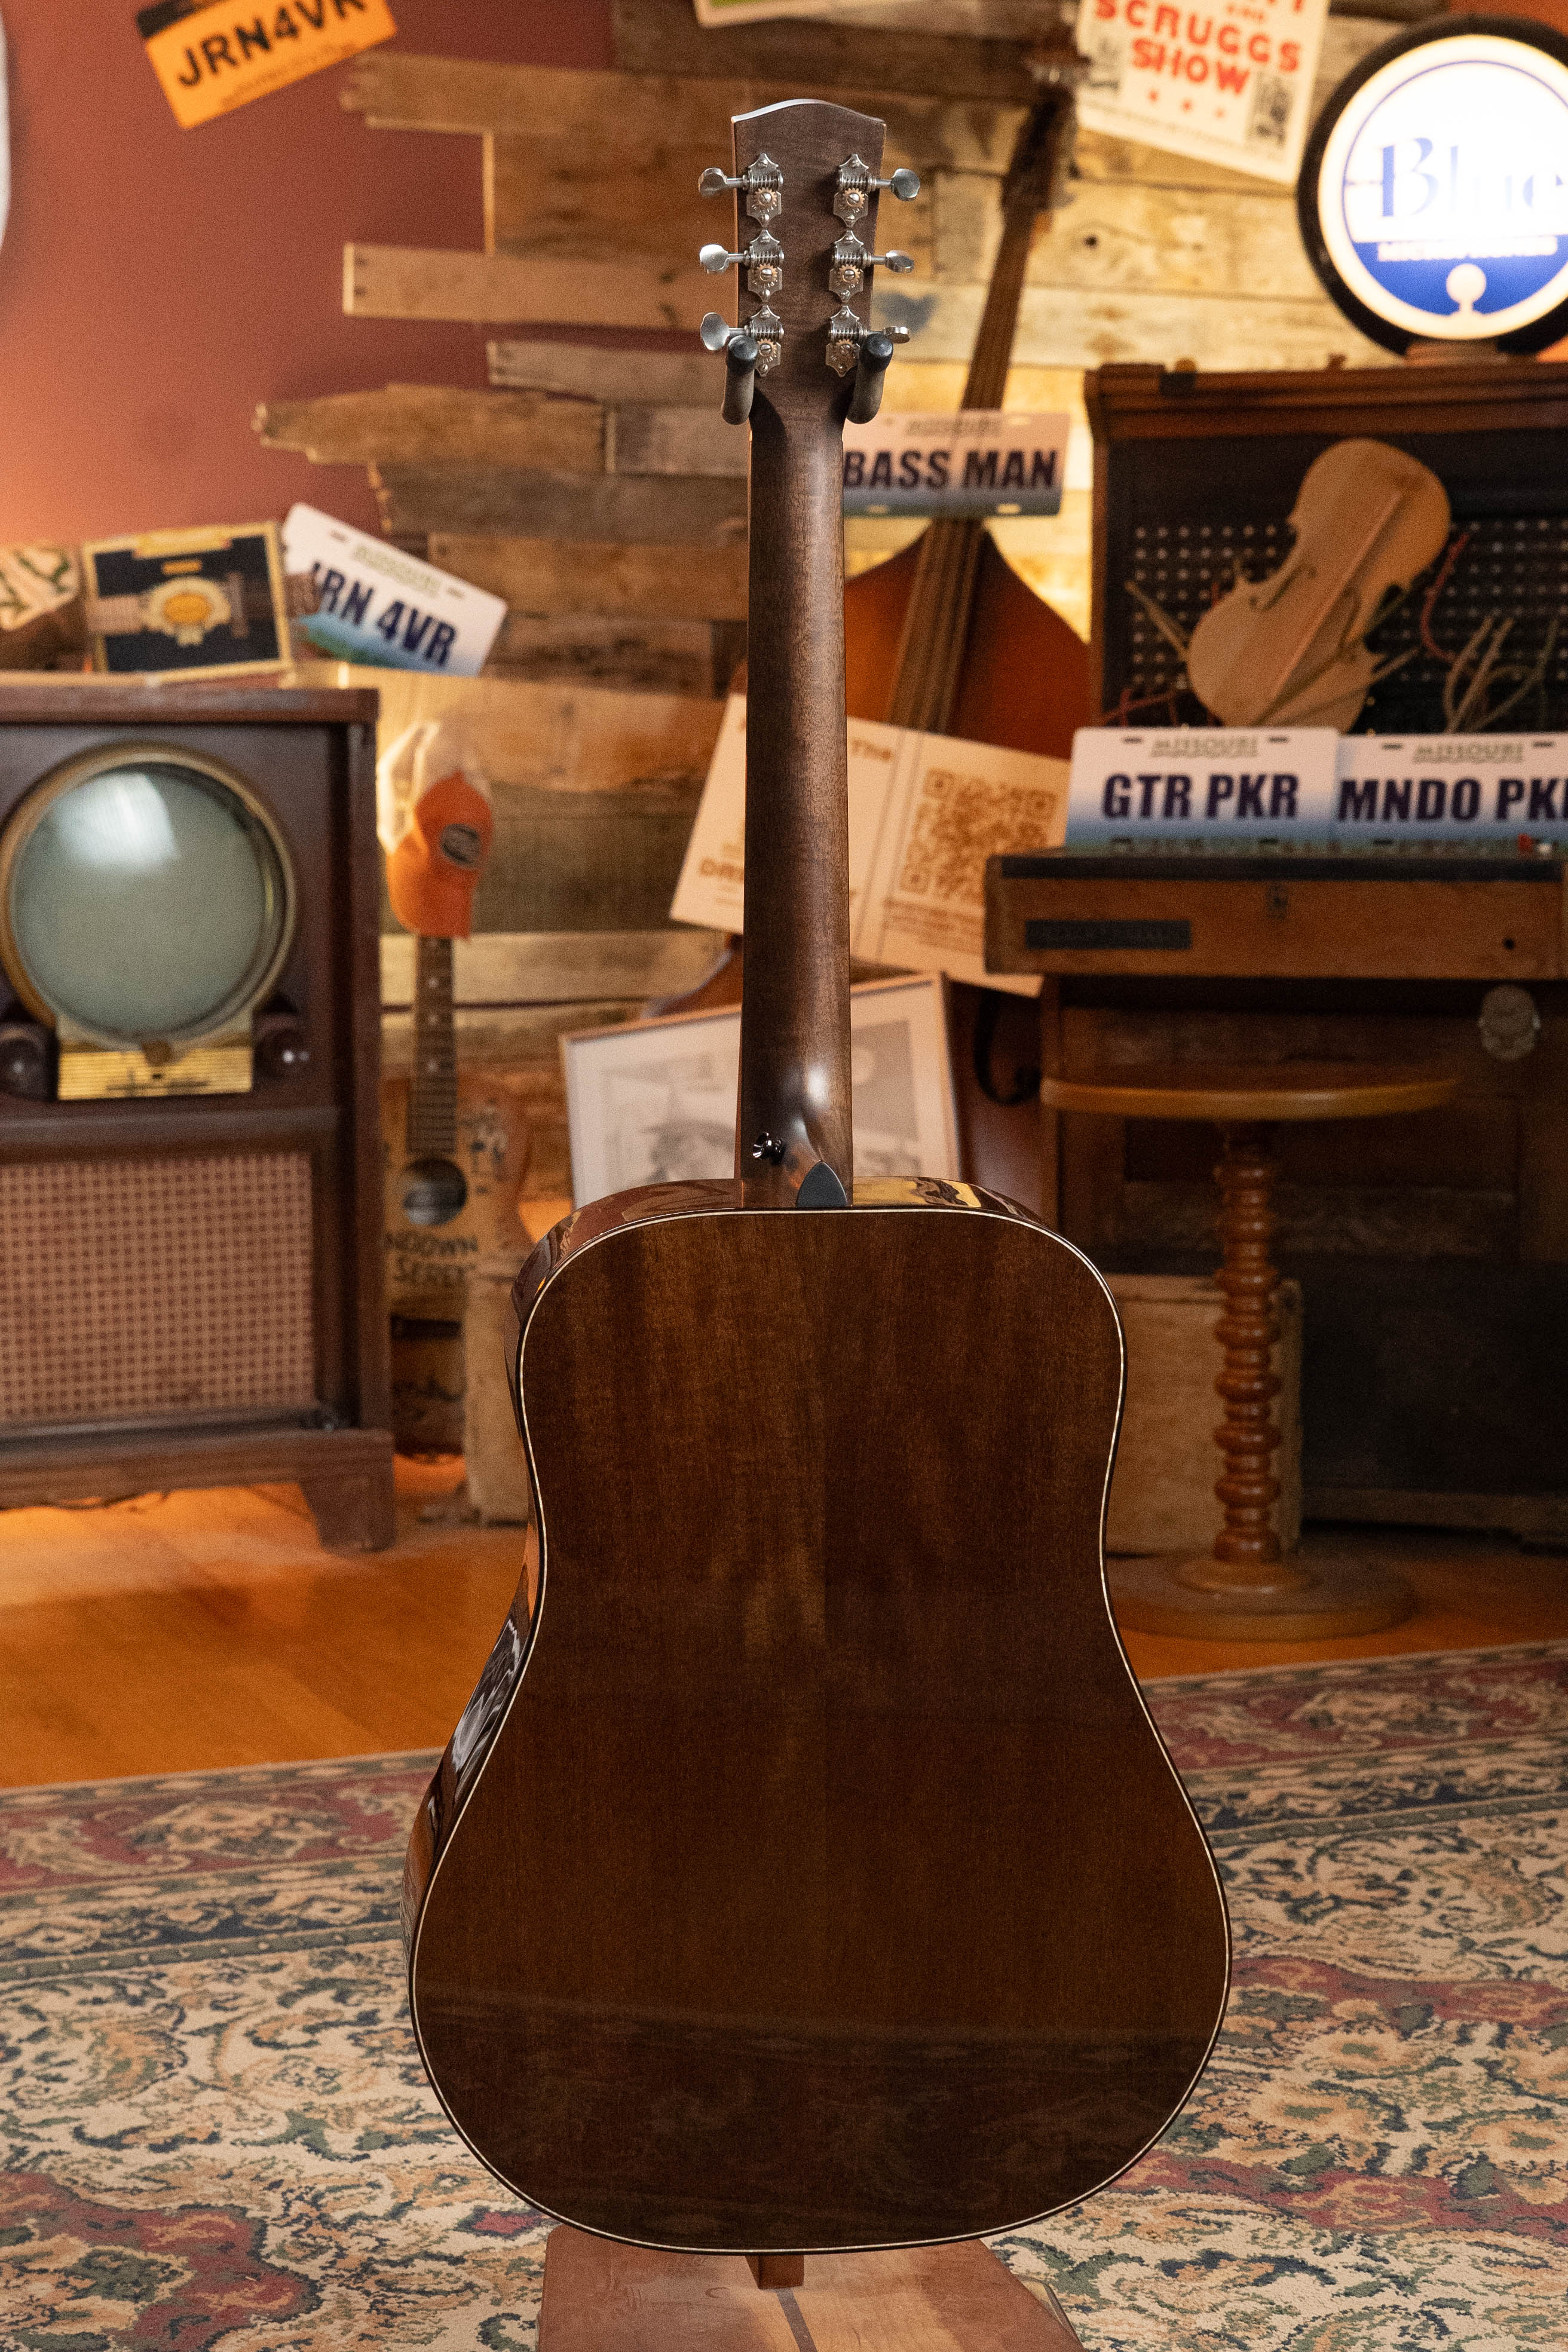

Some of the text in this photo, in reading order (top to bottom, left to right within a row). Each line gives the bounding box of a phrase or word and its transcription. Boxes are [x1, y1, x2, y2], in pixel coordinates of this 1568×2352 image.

[1095, 0, 1301, 72] SCRUGGS
[1132, 38, 1250, 95] SHOW
[844, 449, 1058, 489] BASS MAN
[313, 560, 375, 627] RN
[378, 598, 457, 667] 4VR
[1102, 773, 1299, 820] GTR PKR
[1337, 778, 1568, 822] MNDO PK
